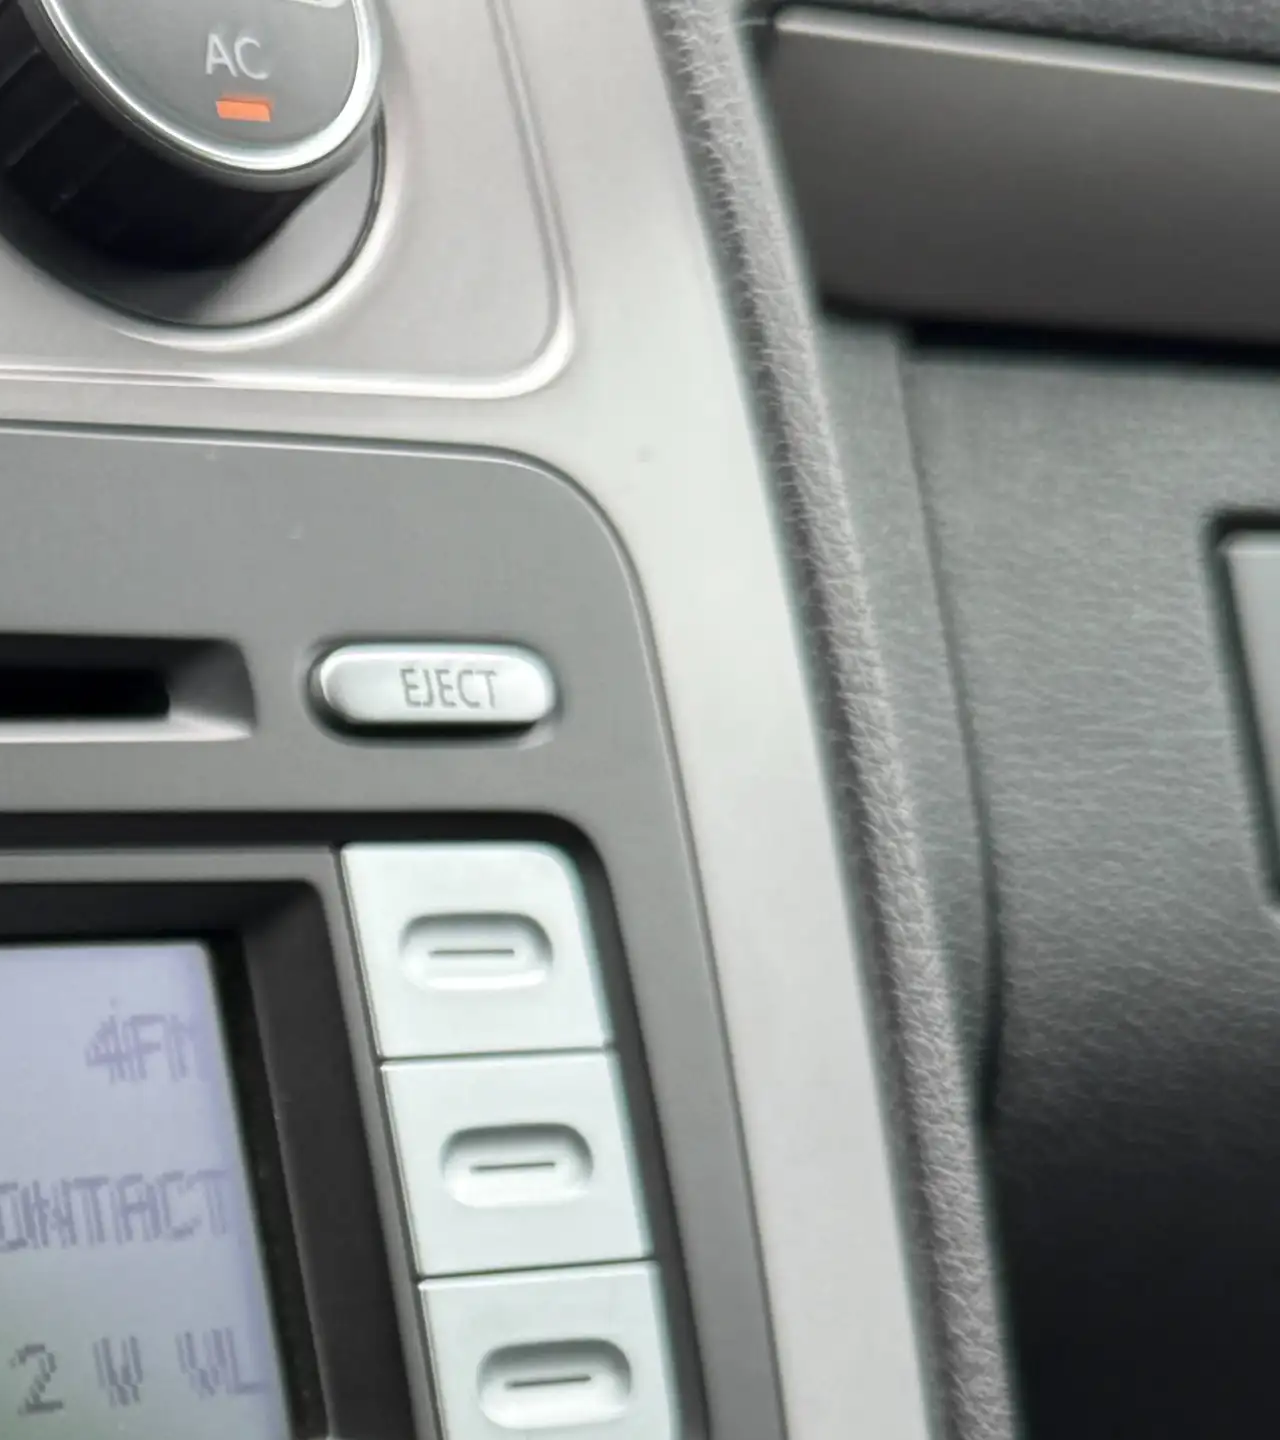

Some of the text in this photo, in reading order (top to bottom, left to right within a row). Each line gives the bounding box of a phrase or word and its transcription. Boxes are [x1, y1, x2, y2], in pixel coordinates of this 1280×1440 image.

[205, 32, 270, 80] AC
[400, 667, 498, 710] EJECT
[9, 1342, 65, 1418] 2
